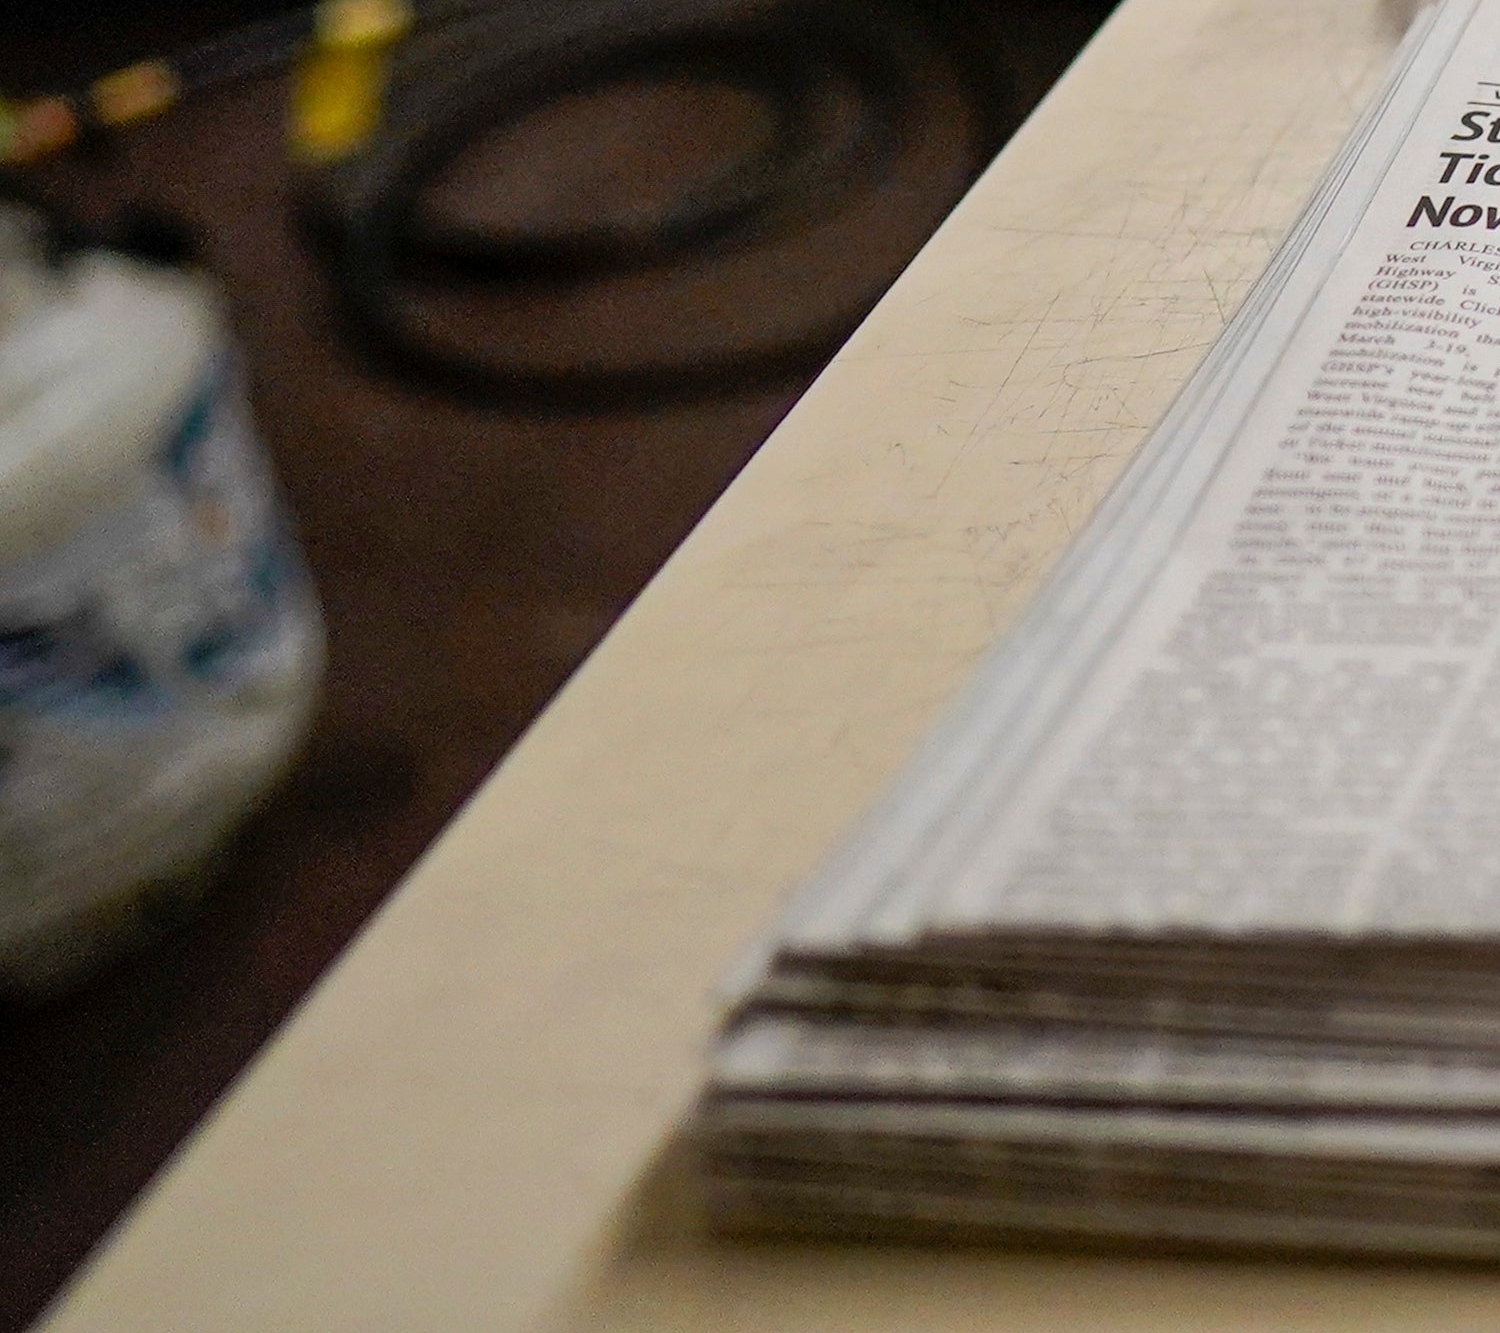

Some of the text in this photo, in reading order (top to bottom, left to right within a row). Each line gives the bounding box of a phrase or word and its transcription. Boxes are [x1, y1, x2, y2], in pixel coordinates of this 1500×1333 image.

[1386, 253, 1427, 264] West
[1375, 266, 1457, 279] Highway
[1368, 279, 1440, 292] (GHSP)
[1463, 285, 1477, 296] is
[1361, 293, 1446, 306] statewide
[1353, 305, 1482, 329] high-visibility
